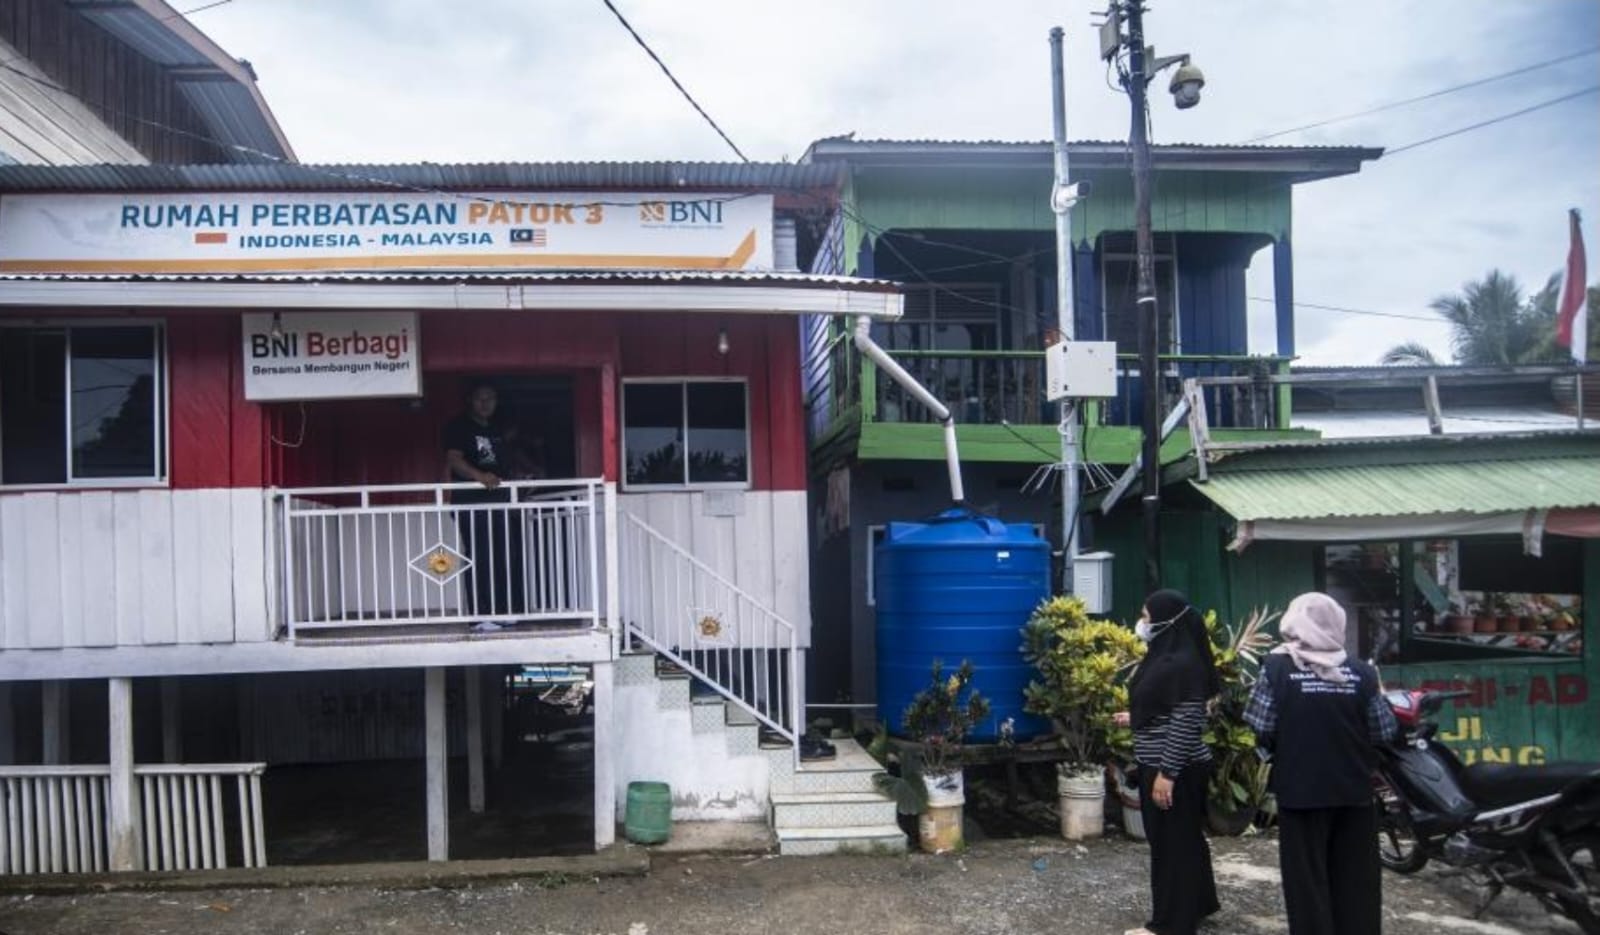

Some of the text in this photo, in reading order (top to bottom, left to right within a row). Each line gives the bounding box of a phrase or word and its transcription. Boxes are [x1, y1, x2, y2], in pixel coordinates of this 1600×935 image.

[121, 202, 604, 228] RUMAH PERBATASAN PATOK 3
[671, 200, 723, 223] BNI
[240, 234, 361, 248] INDONESIA
[382, 232, 493, 247] MALAYSIA
[252, 329, 409, 359] BNI Berbagi
[252, 360, 410, 375] Bersama Membangun Negeri
